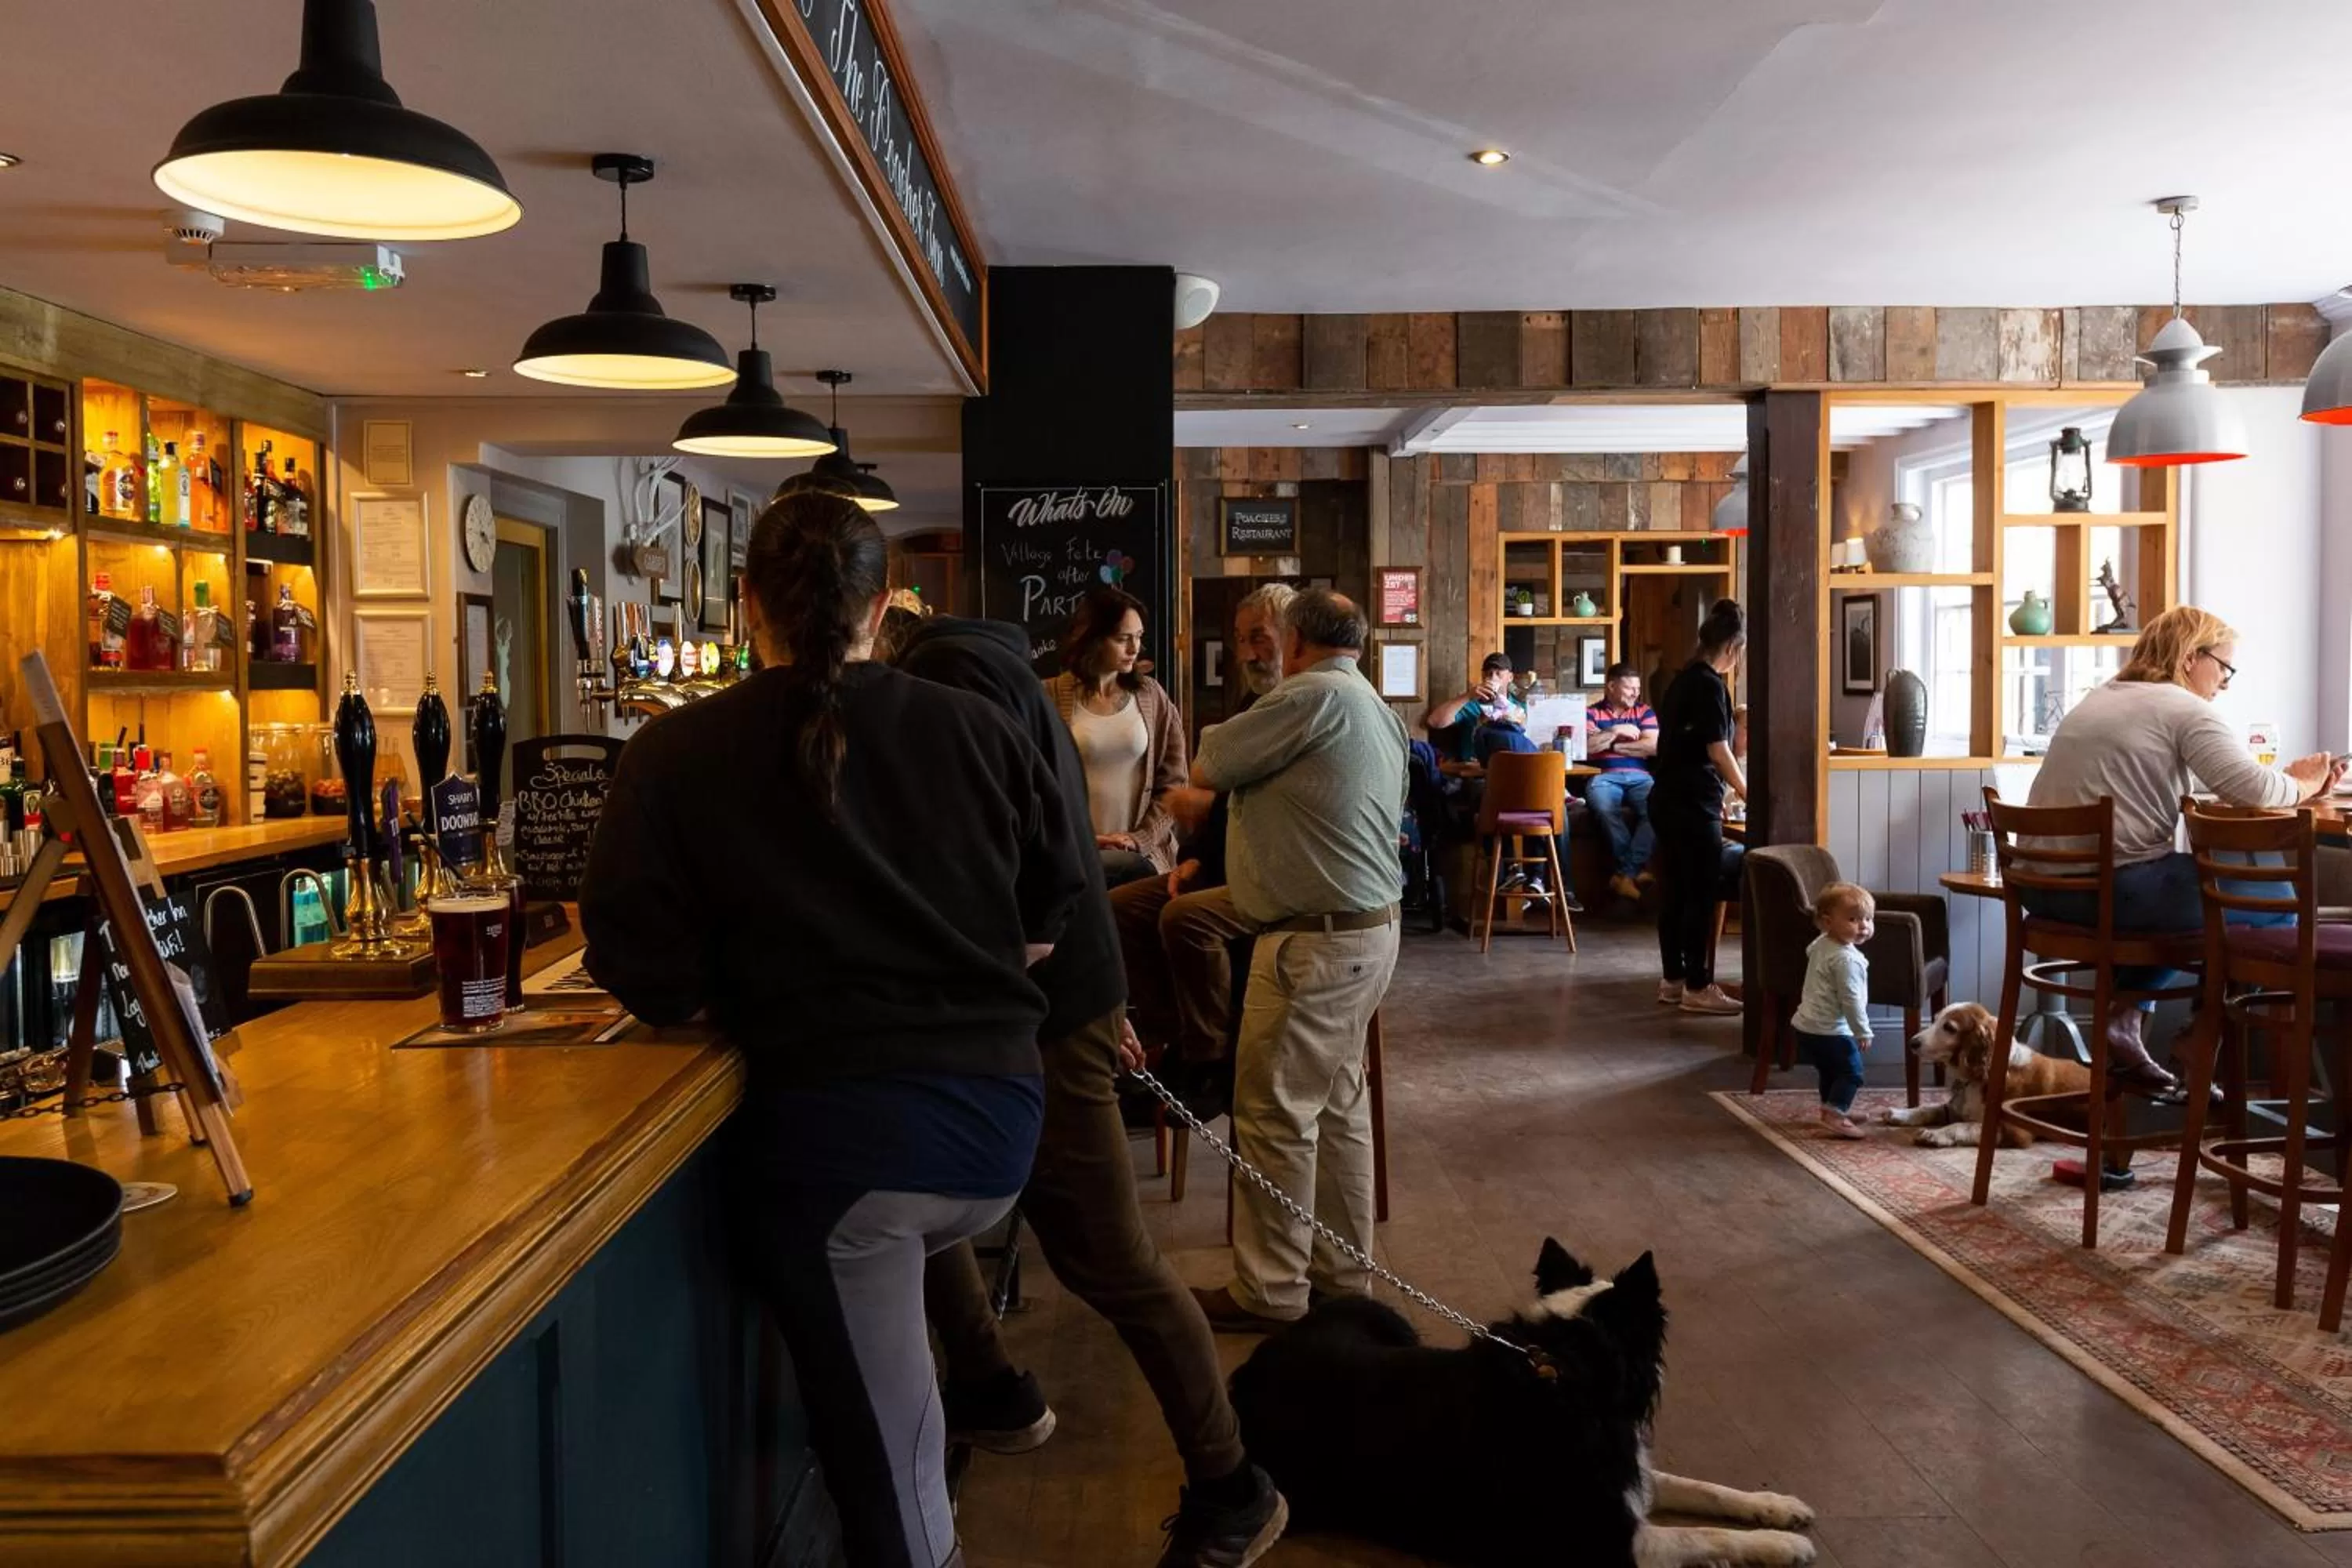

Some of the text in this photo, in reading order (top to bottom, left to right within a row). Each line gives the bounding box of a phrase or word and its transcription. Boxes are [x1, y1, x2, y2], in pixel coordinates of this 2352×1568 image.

[1096, 485, 1134, 519] On
[1232, 526, 1293, 542] RESTAURANT
[1000, 539, 1053, 569] Village
[1058, 565, 1091, 586] after
[1020, 575, 1086, 622] PART
[1030, 639, 1058, 660] aoke
[530, 762, 608, 789] Specials
[518, 790, 558, 812] BBQ
